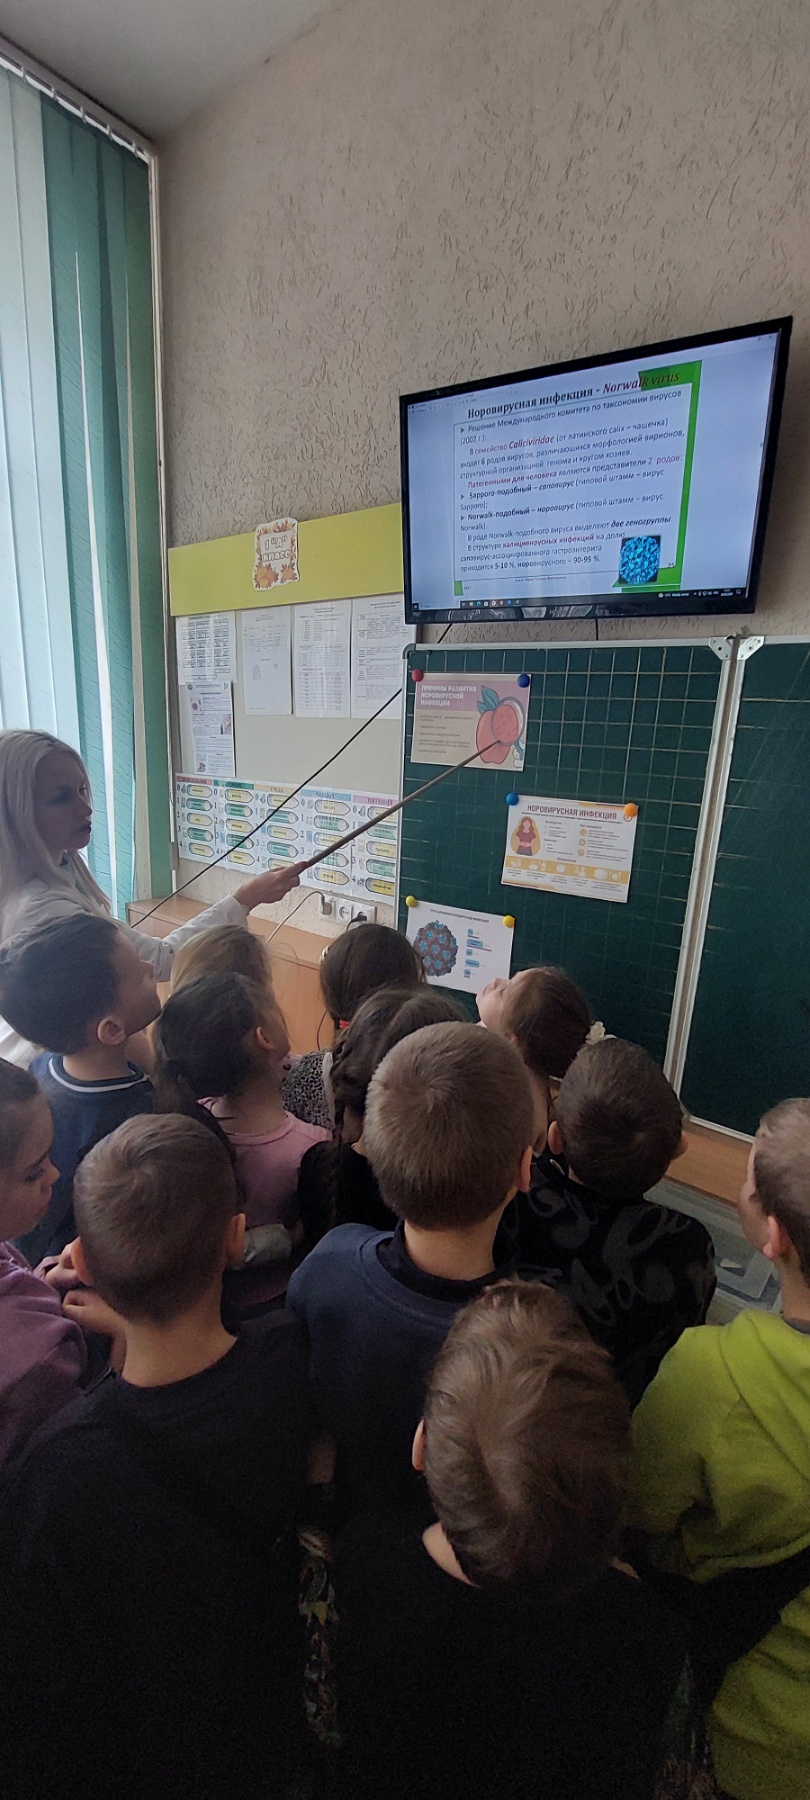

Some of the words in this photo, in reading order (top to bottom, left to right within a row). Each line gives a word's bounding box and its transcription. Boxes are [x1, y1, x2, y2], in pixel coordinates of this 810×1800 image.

[468, 398, 537, 420] Норовирусная
[539, 387, 593, 405] инфекция
[603, 377, 649, 394] Norwalk
[651, 373, 680, 385] virus
[468, 424, 496, 432] Решение
[497, 411, 556, 427] Международного
[557, 406, 590, 417] комитета
[603, 397, 648, 409] таксономии
[649, 390, 682, 403] вирусов
[469, 448, 474, 456] В
[474, 444, 508, 454] семейство
[508, 434, 555, 450] Caliciviridae
[568, 428, 607, 440] латинского
[608, 424, 625, 434] calix
[632, 418, 669, 431] чашечка)
[480, 457, 486, 465] 6
[486, 457, 506, 466] родов
[536, 444, 591, 457] различающихся
[592, 435, 643, 449] морфологией
[644, 430, 685, 442] вирионов,
[460, 467, 498, 479] структурной
[498, 460, 544, 474] организацией
[546, 457, 572, 466] генома
[579, 453, 605, 463] кругом
[468, 477, 511, 488] Патогенными
[512, 475, 525, 484] для
[525, 471, 557, 480] человека
[558, 466, 591, 476] являются
[592, 459, 647, 473] представители
[647, 457, 653, 465] 2
[469, 484, 532, 500] Sapporo-подобный
[575, 475, 608, 487] (типовой
[608, 474, 635, 482] штамм
[642, 469, 664, 479] вирус
[467, 506, 530, 521] Norwalk-подобный
[575, 499, 607, 509] (типовой
[608, 497, 635, 505] штамм
[642, 493, 664, 502] вирус
[472, 533, 488, 542] роде
[489, 527, 550, 539] Norwalk-подобного
[551, 525, 573, 534] вируса
[574, 522, 610, 531] выделяют
[610, 520, 623, 528] две
[472, 543, 502, 552] структуре
[558, 534, 594, 543] инфекций
[605, 531, 626, 540] долю
[460, 563, 494, 572] приходится
[494, 561, 508, 569] 5-10
[517, 558, 566, 568] норовирусного
[573, 555, 592, 564] 90-95
[551, 545, 602, 555] гастроэнтерита
[527, 804, 578, 816] НОРОВИРУСНАЯ
[579, 809, 617, 820] ИНФЕКЦИЯ
